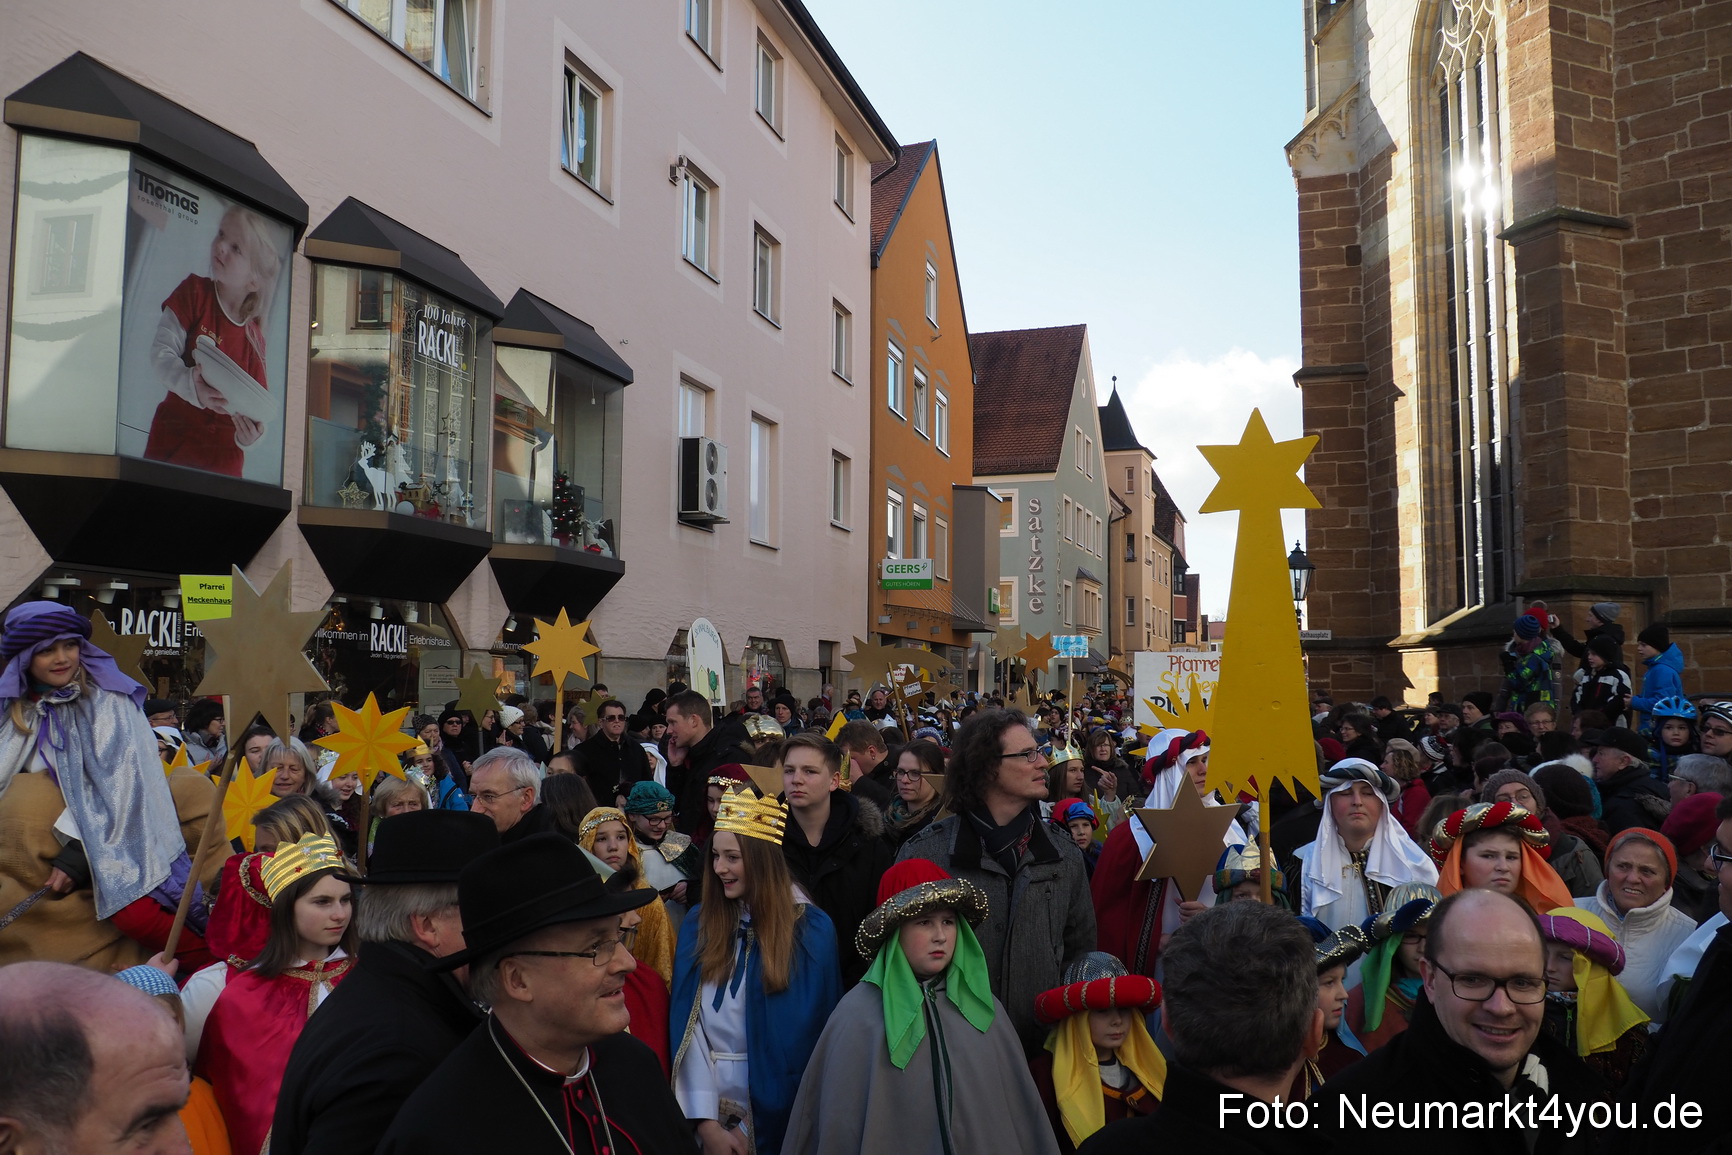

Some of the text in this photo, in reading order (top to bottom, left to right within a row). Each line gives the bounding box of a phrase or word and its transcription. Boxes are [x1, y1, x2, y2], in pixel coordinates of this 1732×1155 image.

[135, 168, 199, 215] Thomas
[138, 195, 199, 225] rosenthal group
[423, 304, 467, 328] 100 Jahre
[418, 320, 459, 368] RACKL
[885, 564, 921, 574] GEERS
[1027, 498, 1046, 616] satzke
[187, 596, 232, 605] Meckenhaus
[199, 583, 226, 591] Pfarrei
[121, 607, 181, 648] RACKL
[359, 630, 369, 641] im
[370, 622, 408, 653] RACKL
[1166, 654, 1222, 675] Pfarrei
